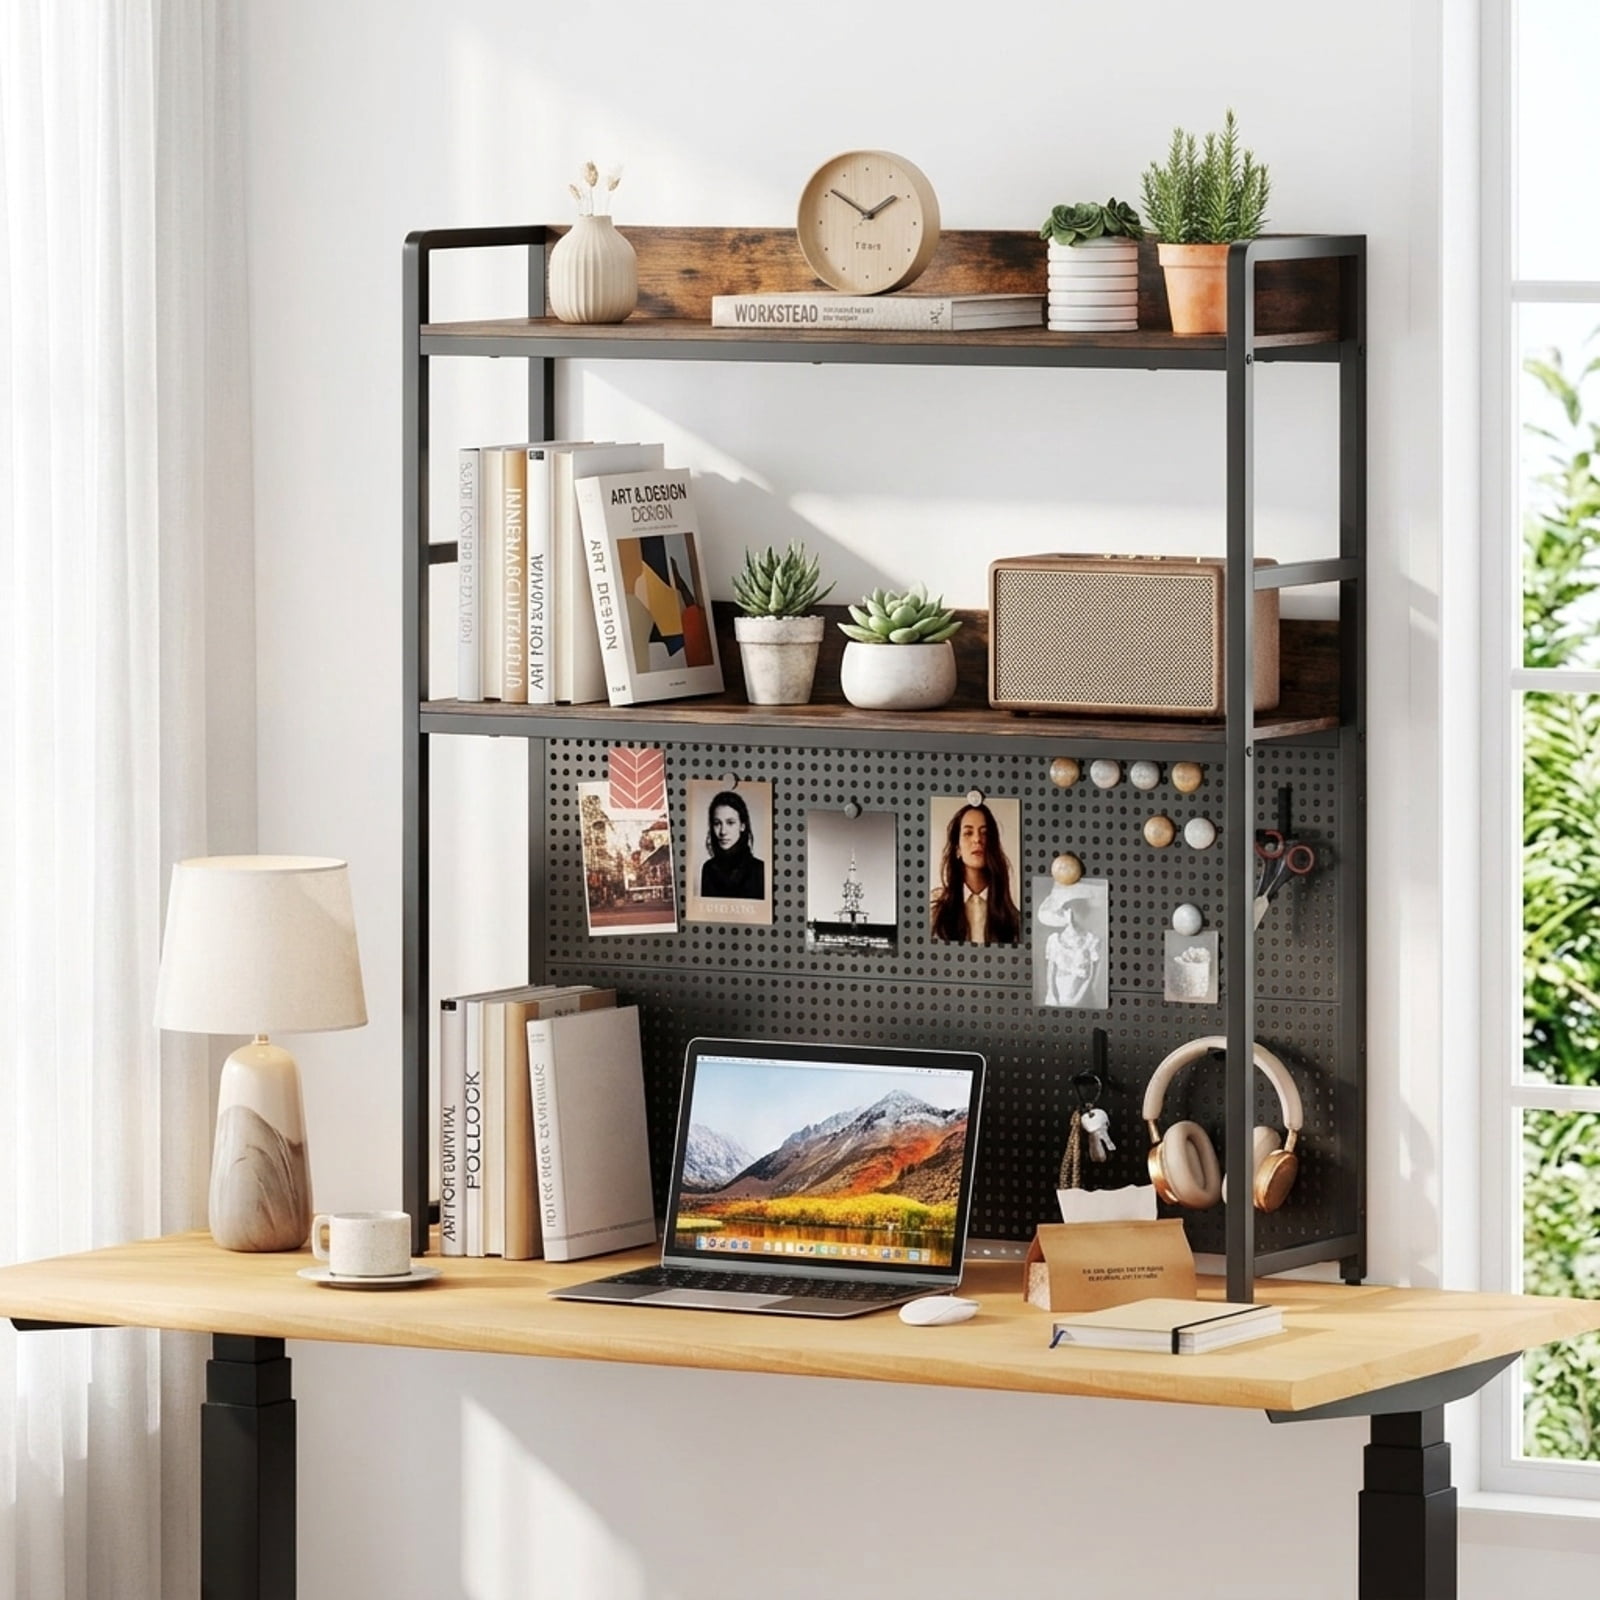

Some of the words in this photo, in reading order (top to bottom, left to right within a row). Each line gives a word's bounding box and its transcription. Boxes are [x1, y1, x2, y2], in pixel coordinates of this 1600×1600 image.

[735, 304, 818, 323] WORKSTEAD
[611, 488, 632, 505] ART
[634, 487, 645, 503] &
[645, 483, 687, 502] DESIGN
[590, 540, 606, 573] ART
[465, 1071, 480, 1190] POLLOCK
